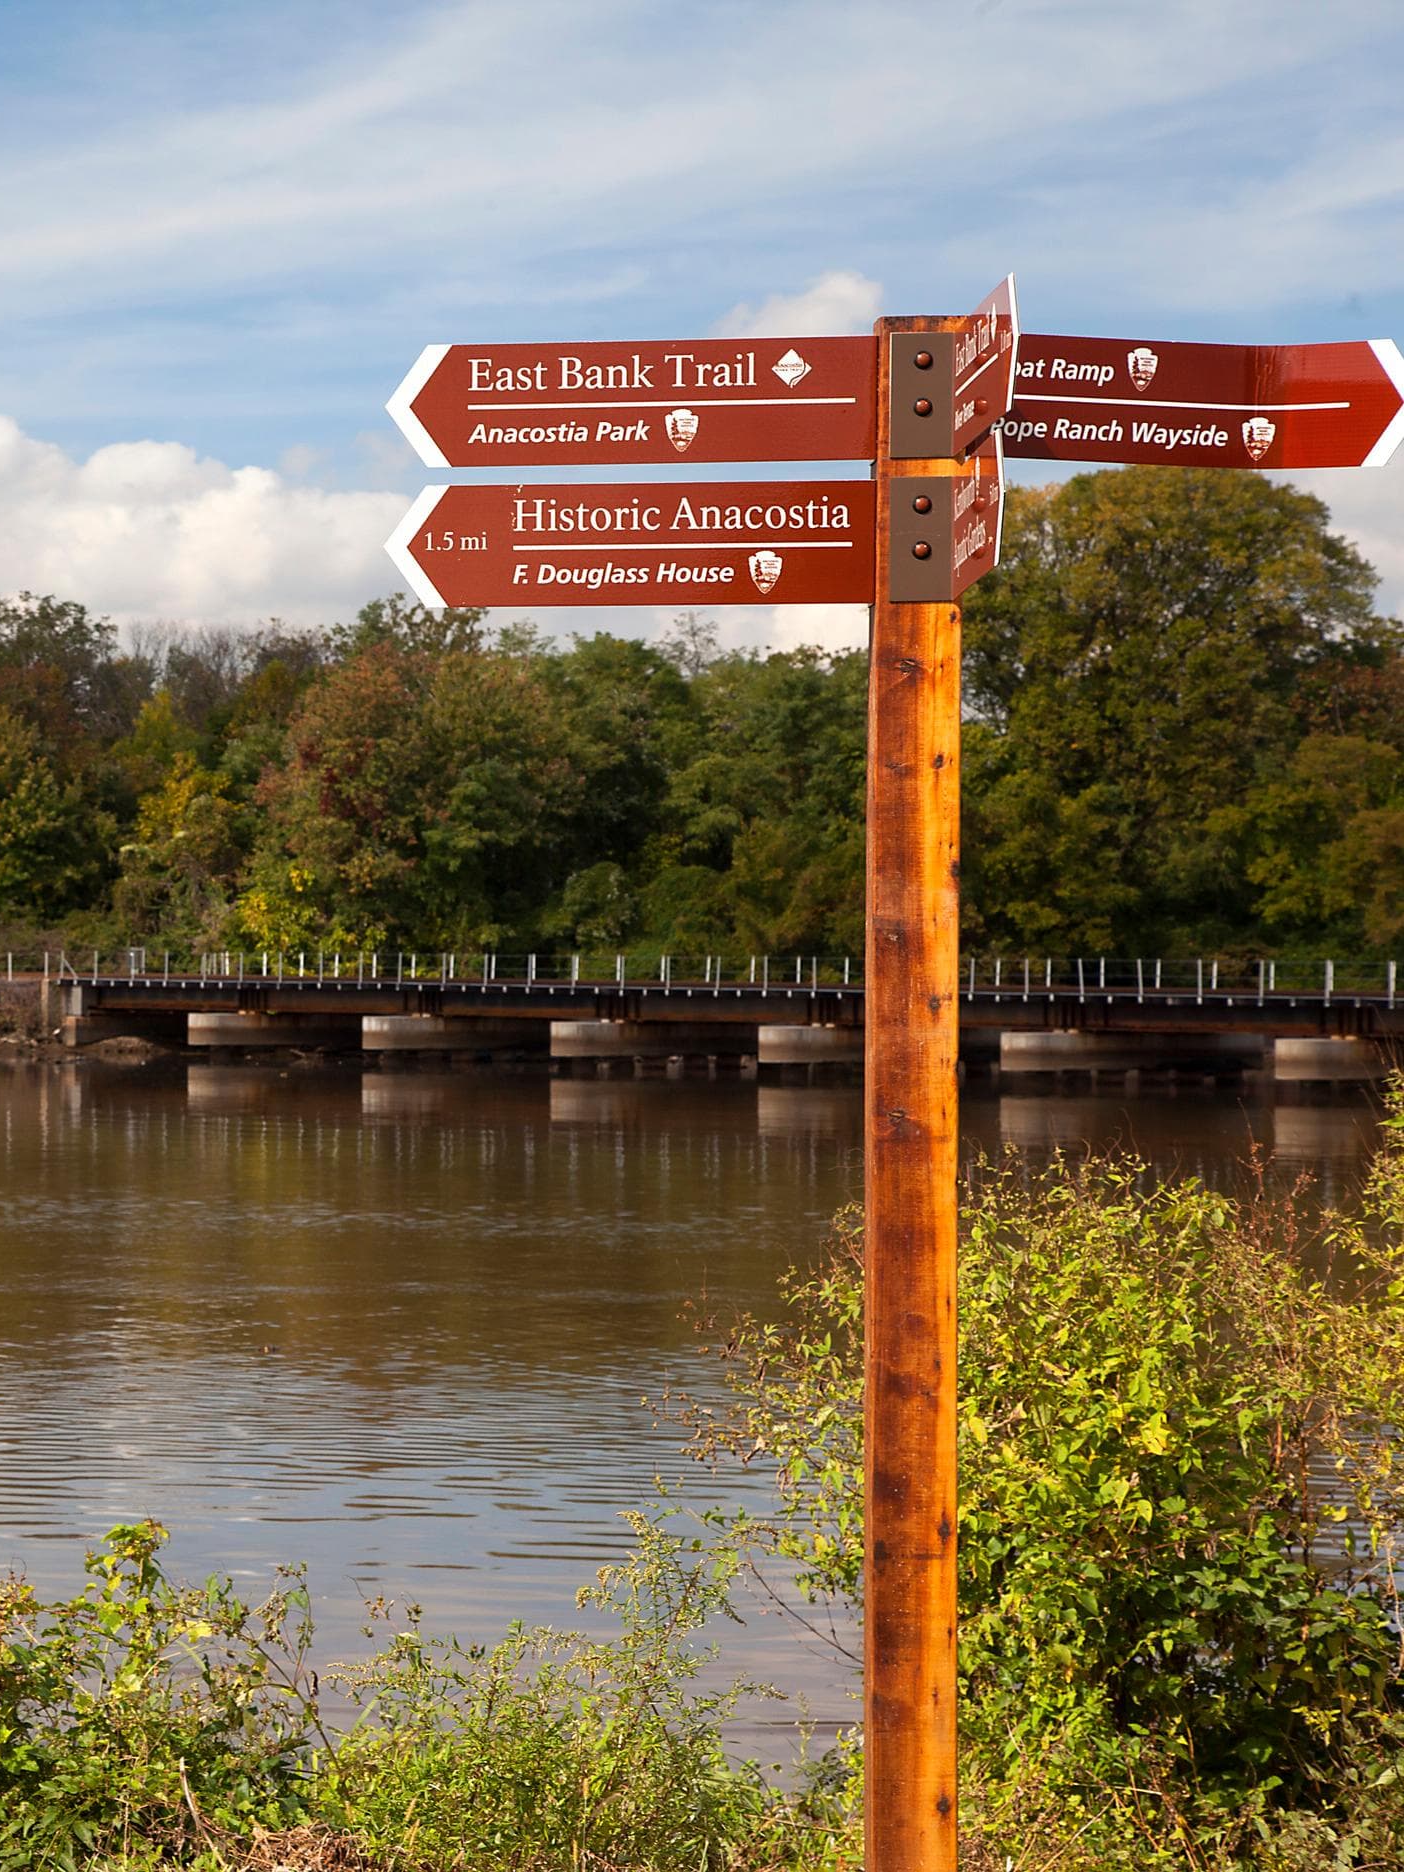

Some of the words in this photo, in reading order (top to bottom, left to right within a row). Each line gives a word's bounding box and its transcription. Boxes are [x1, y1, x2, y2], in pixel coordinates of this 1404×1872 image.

[467, 358, 548, 392] East
[557, 354, 655, 390] Bank
[664, 352, 757, 388] Trail
[1050, 358, 1115, 387] Ramp
[467, 421, 589, 444] Anacostia
[595, 419, 651, 442] Park
[1053, 418, 1124, 442] Ranch
[1131, 421, 1229, 450] Wayside
[513, 497, 661, 532] Historic
[669, 494, 852, 531] Anacostia
[424, 531, 454, 551] 1.5
[459, 531, 488, 551] mi
[512, 564, 529, 585] F.
[536, 562, 650, 590] Douglass
[656, 561, 735, 584] House
